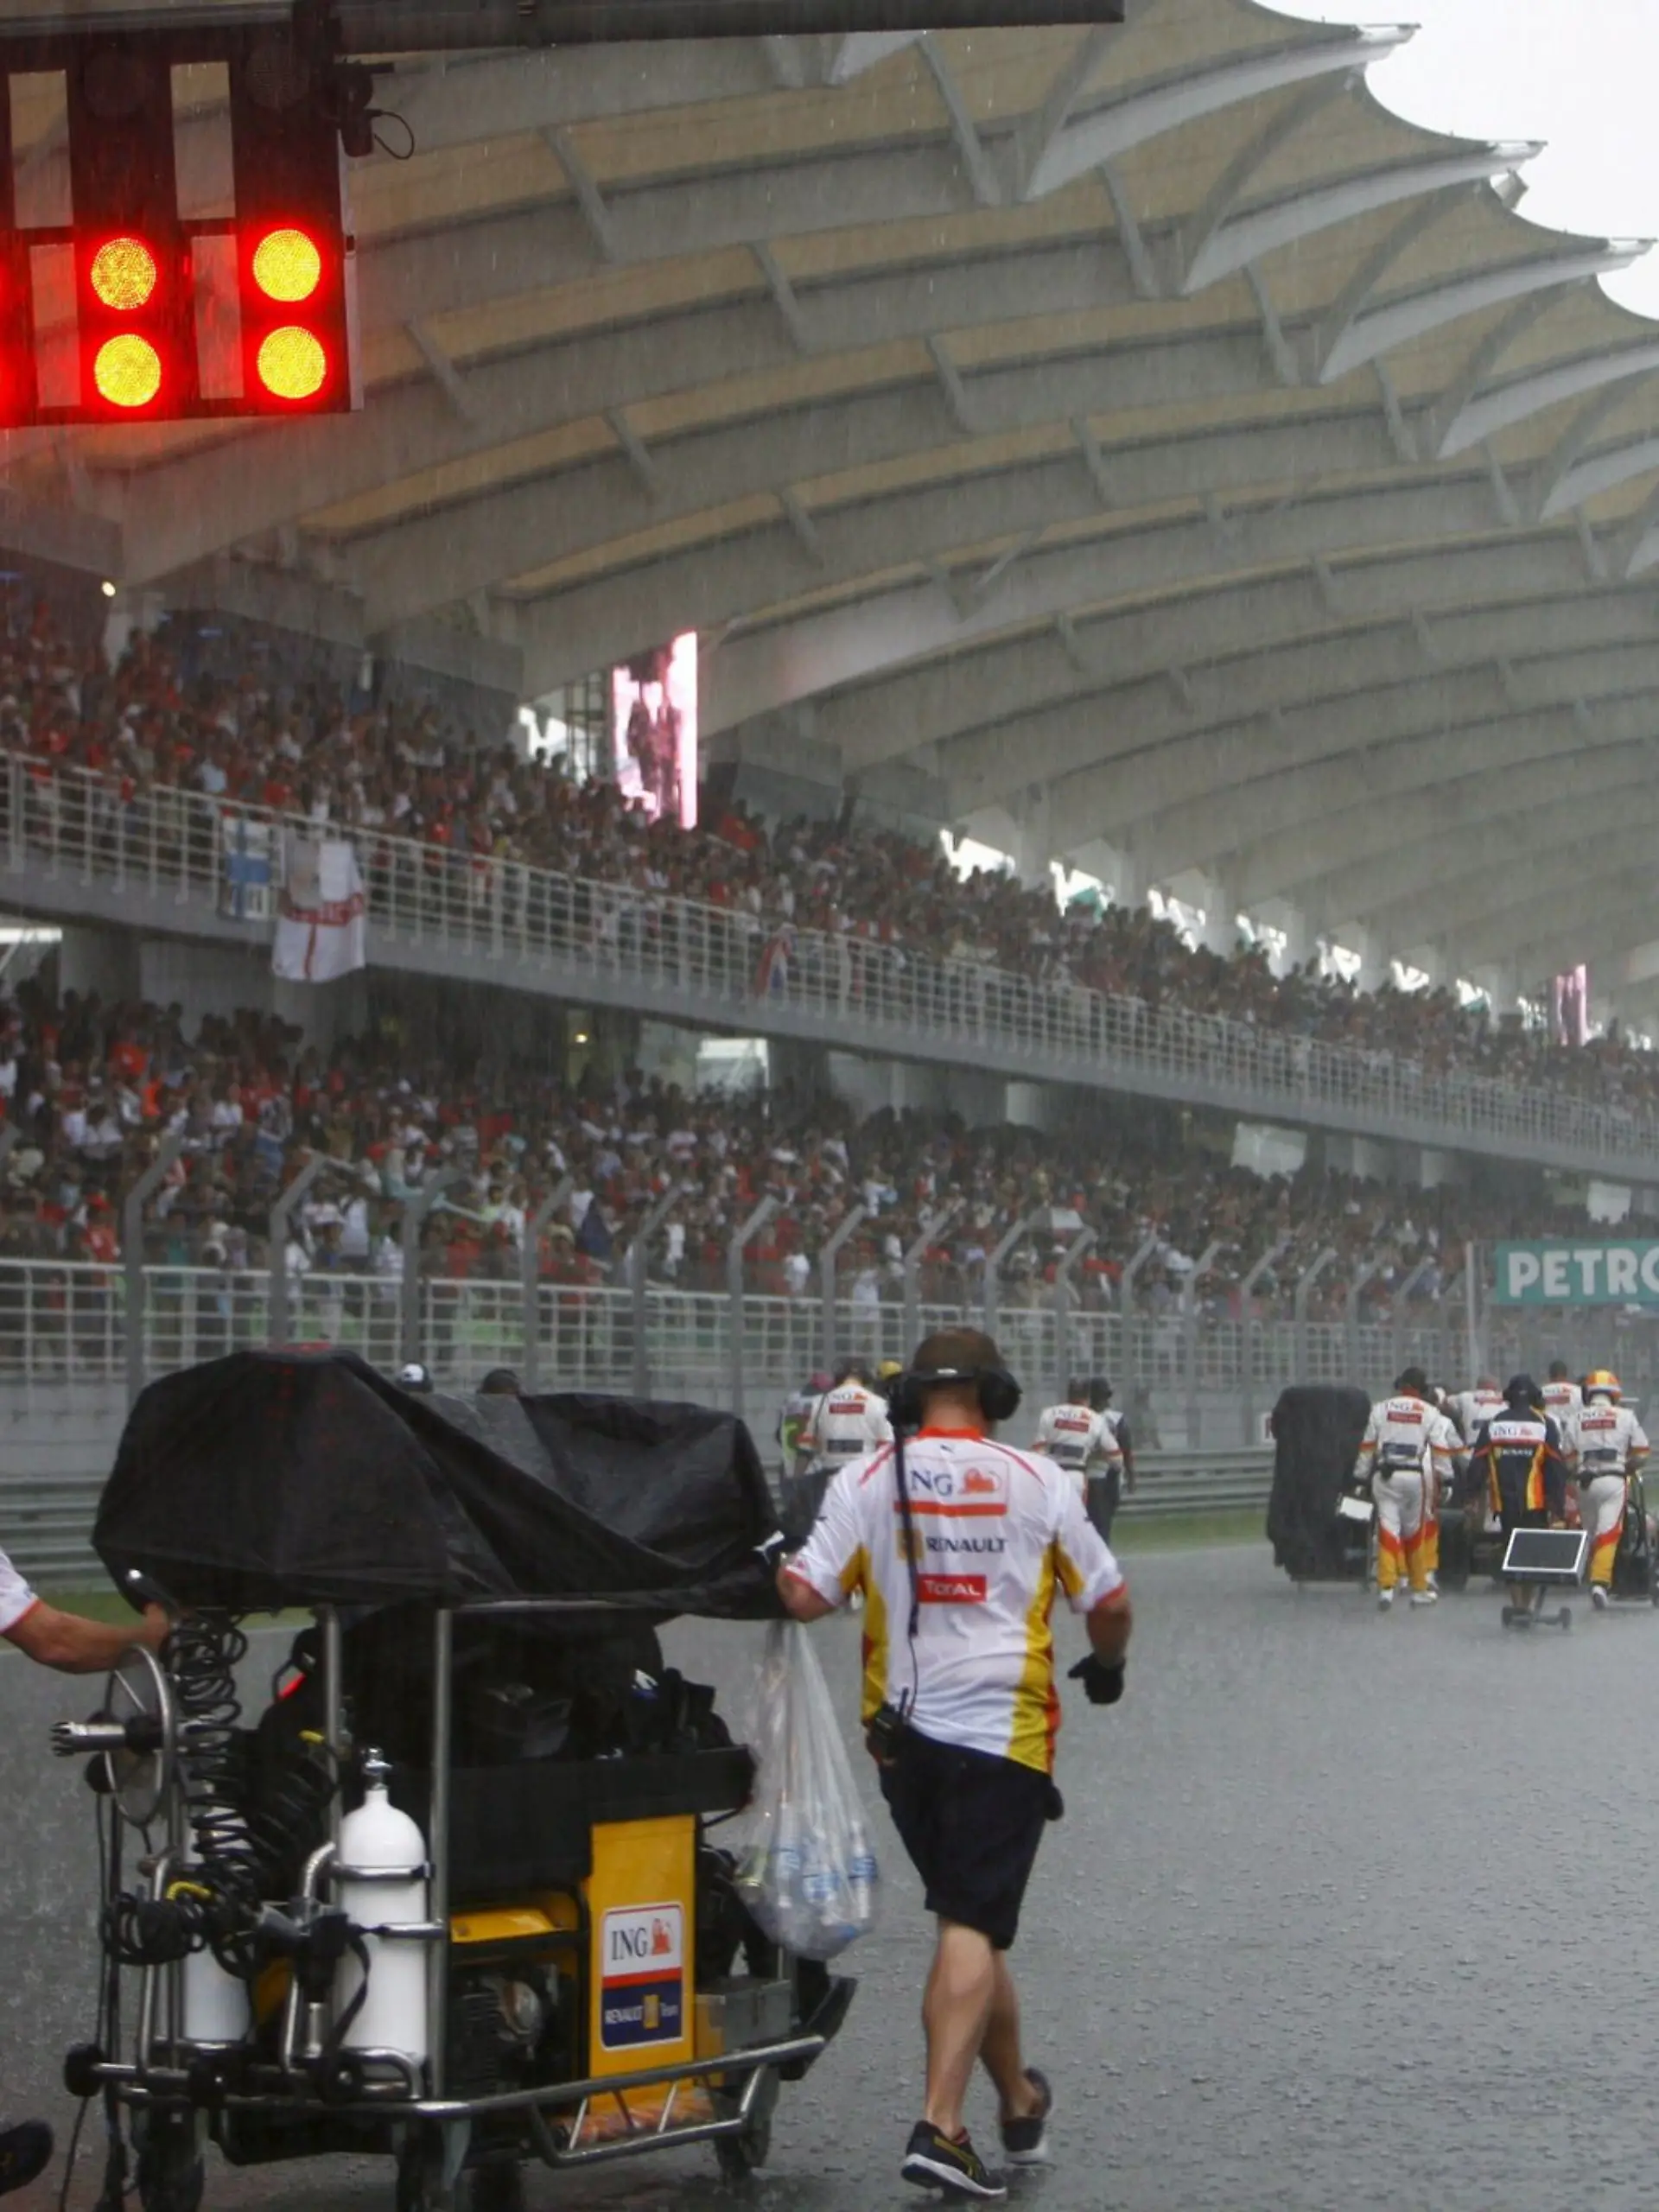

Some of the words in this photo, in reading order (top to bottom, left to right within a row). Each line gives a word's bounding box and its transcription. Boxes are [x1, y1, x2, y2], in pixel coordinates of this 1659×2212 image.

[1492, 1424, 1517, 1436] ING
[908, 1470, 954, 1496] NG
[925, 1536, 1008, 1554] RENAULT
[611, 1927, 648, 1961] ING
